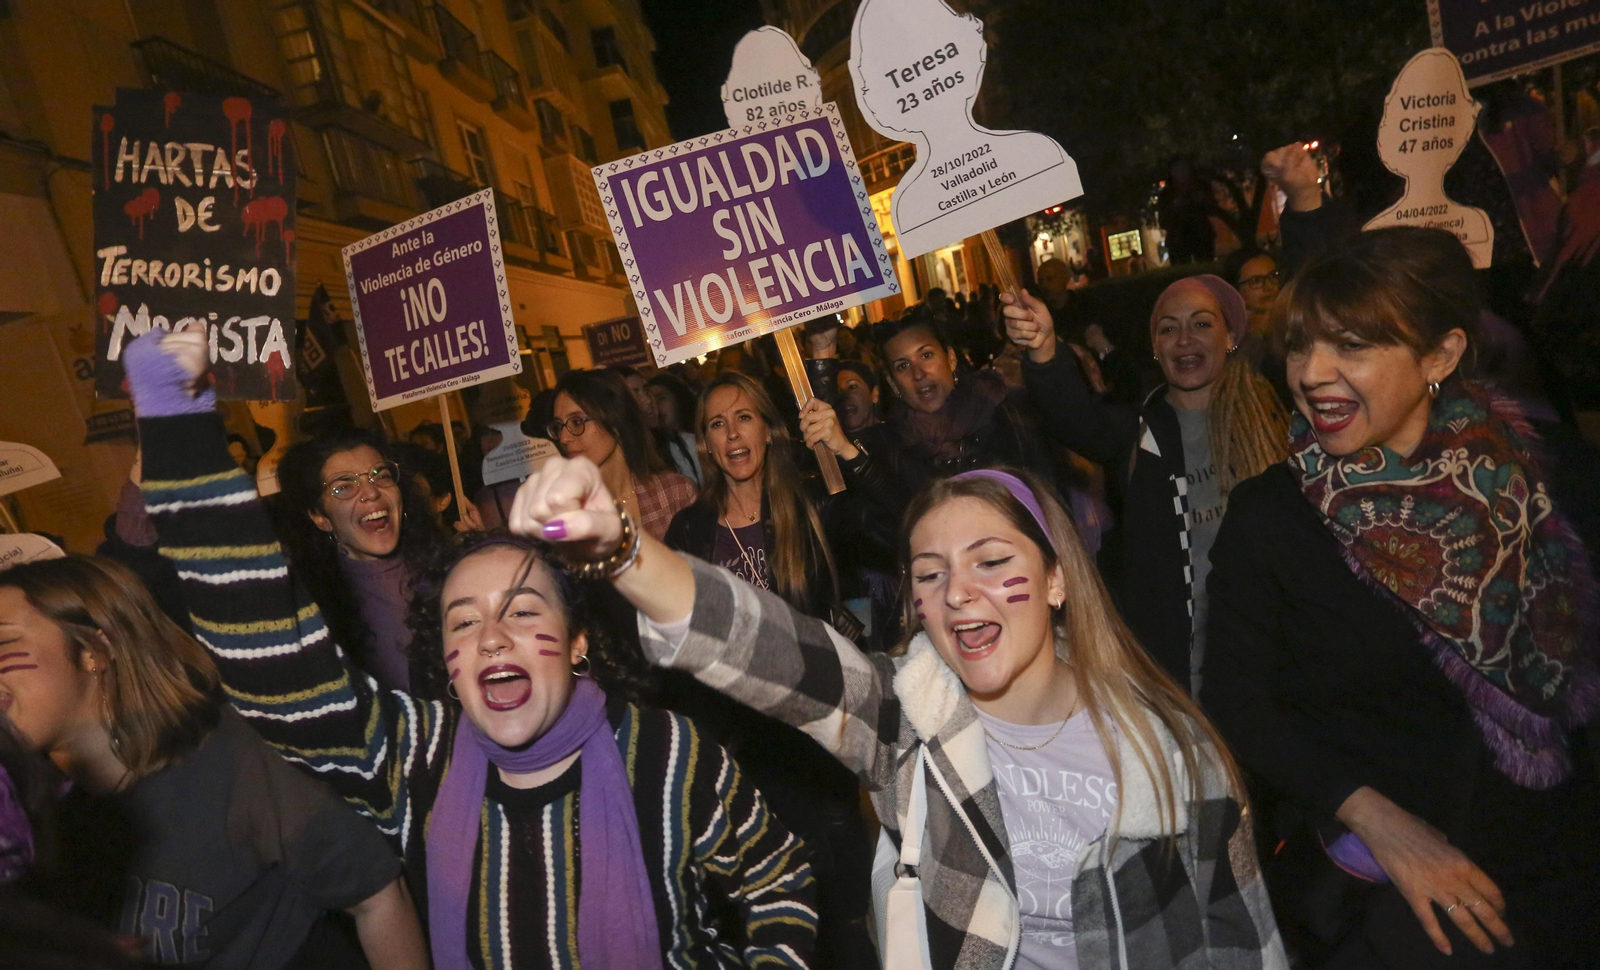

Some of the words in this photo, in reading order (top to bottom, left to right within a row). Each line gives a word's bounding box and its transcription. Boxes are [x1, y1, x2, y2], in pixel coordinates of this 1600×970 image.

[1474, 21, 1490, 38] A
[1495, 15, 1515, 31] la
[1457, 37, 1521, 65] ontra
[1526, 25, 1560, 46] las
[885, 42, 959, 89] Teresa
[733, 80, 792, 102] Clotilde
[796, 74, 813, 89] R.
[896, 92, 920, 114] 23
[922, 70, 965, 101] años
[1400, 90, 1456, 111] Victoria
[746, 106, 764, 121] 82
[769, 100, 807, 117] años
[1399, 114, 1456, 132] Cristina
[114, 136, 258, 190] HARTAS
[931, 143, 993, 178] 28/10/2022
[1398, 139, 1418, 154] 47
[1422, 137, 1454, 151] años
[620, 128, 831, 228] IGUALDAD
[937, 187, 978, 211] Castilla
[979, 184, 987, 196] y
[987, 170, 1018, 189] León
[940, 158, 998, 191] Valladolid
[174, 196, 221, 233] DE
[712, 196, 785, 261] SIN
[1396, 203, 1449, 221] 04/04/2022
[392, 238, 420, 259] Ante
[421, 230, 435, 246] la
[360, 264, 413, 295] Violencia
[415, 257, 431, 274] de
[433, 240, 483, 267] Género
[653, 232, 874, 338] VIOLENCIA
[400, 277, 447, 332] ¡NO
[793, 309, 812, 322] Cero
[816, 300, 844, 313] Málaga
[610, 323, 631, 342] NO
[384, 346, 410, 383] TE
[411, 320, 490, 375] CALLES!
[426, 383, 447, 393] Violencia
[447, 380, 459, 388] Cero
